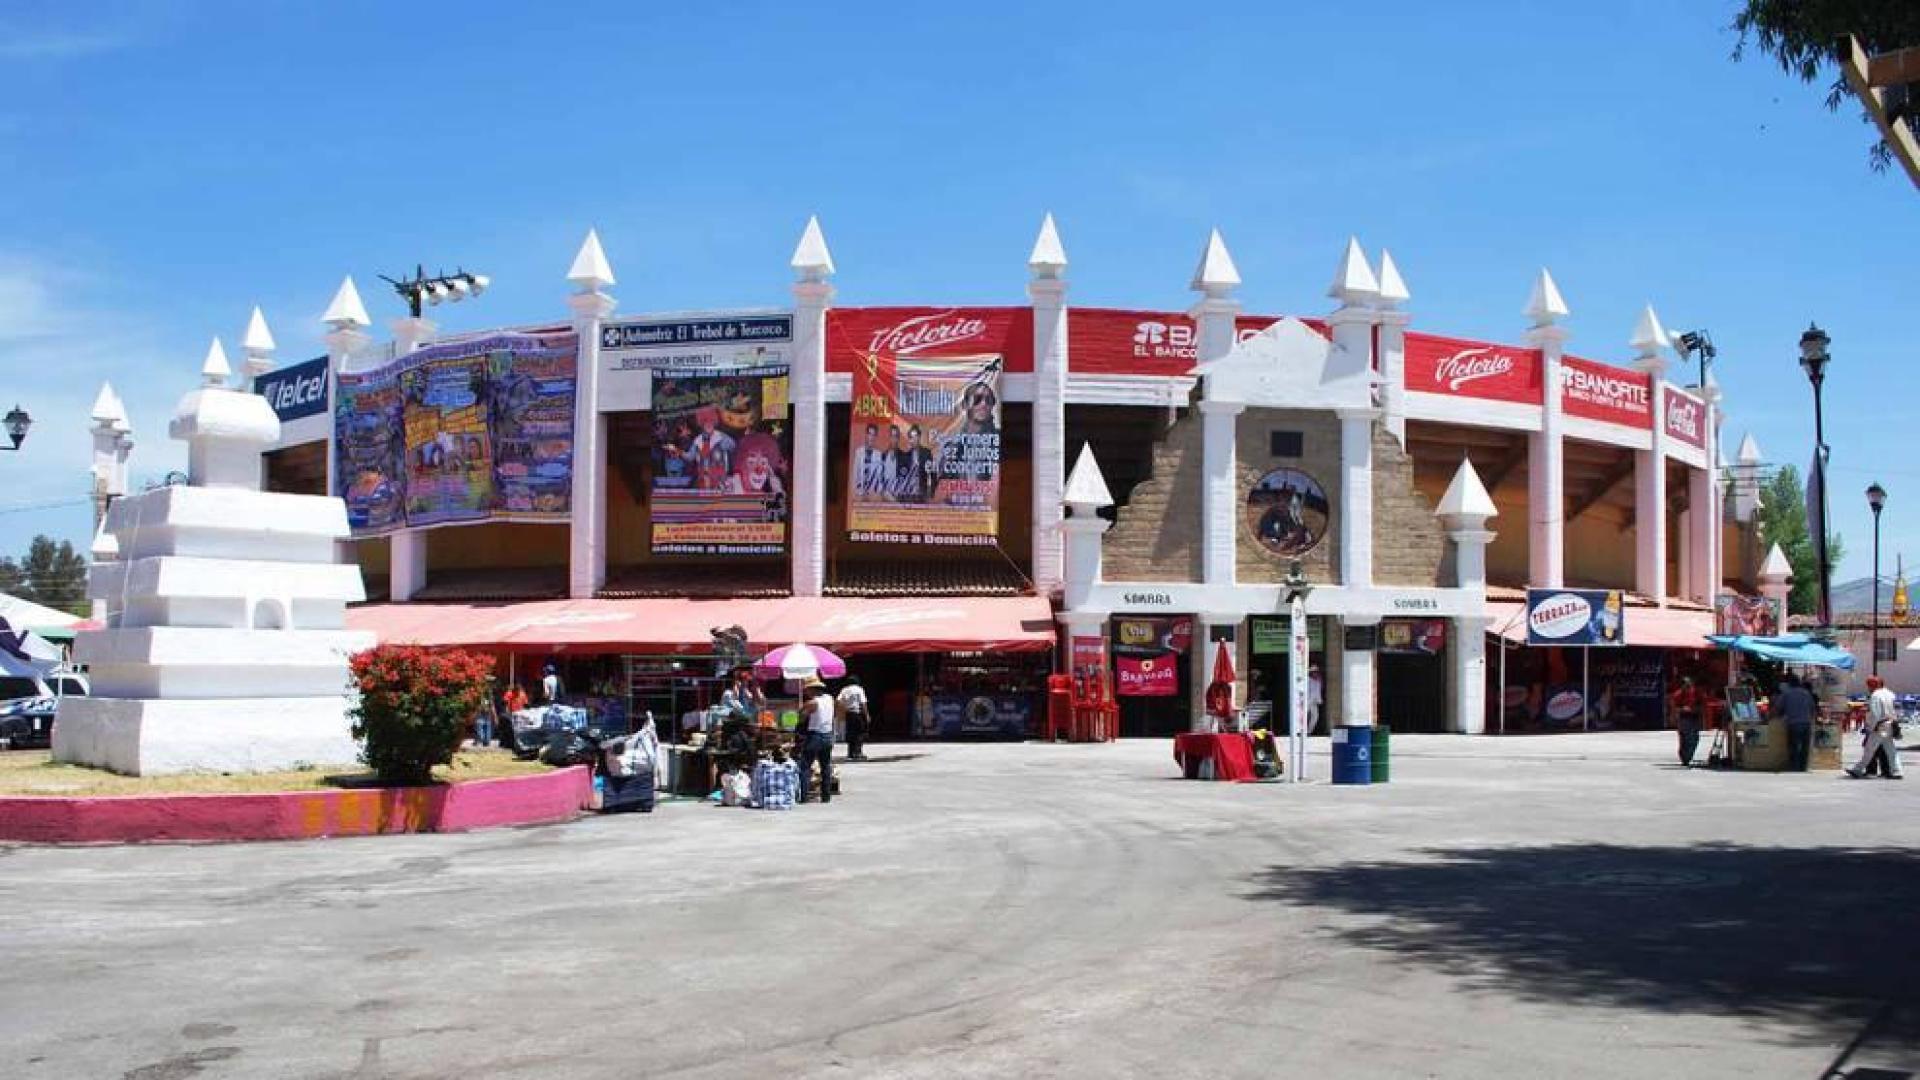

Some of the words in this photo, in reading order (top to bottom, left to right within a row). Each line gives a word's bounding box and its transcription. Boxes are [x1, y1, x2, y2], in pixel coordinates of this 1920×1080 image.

[676, 325, 687, 340] El
[868, 311, 987, 353] Victoria
[1133, 344, 1148, 356] EL
[1434, 348, 1512, 384] Victoria
[275, 368, 327, 410] telcel
[1574, 371, 1650, 406] BANORTE
[1533, 601, 1577, 625] TERRAZA
